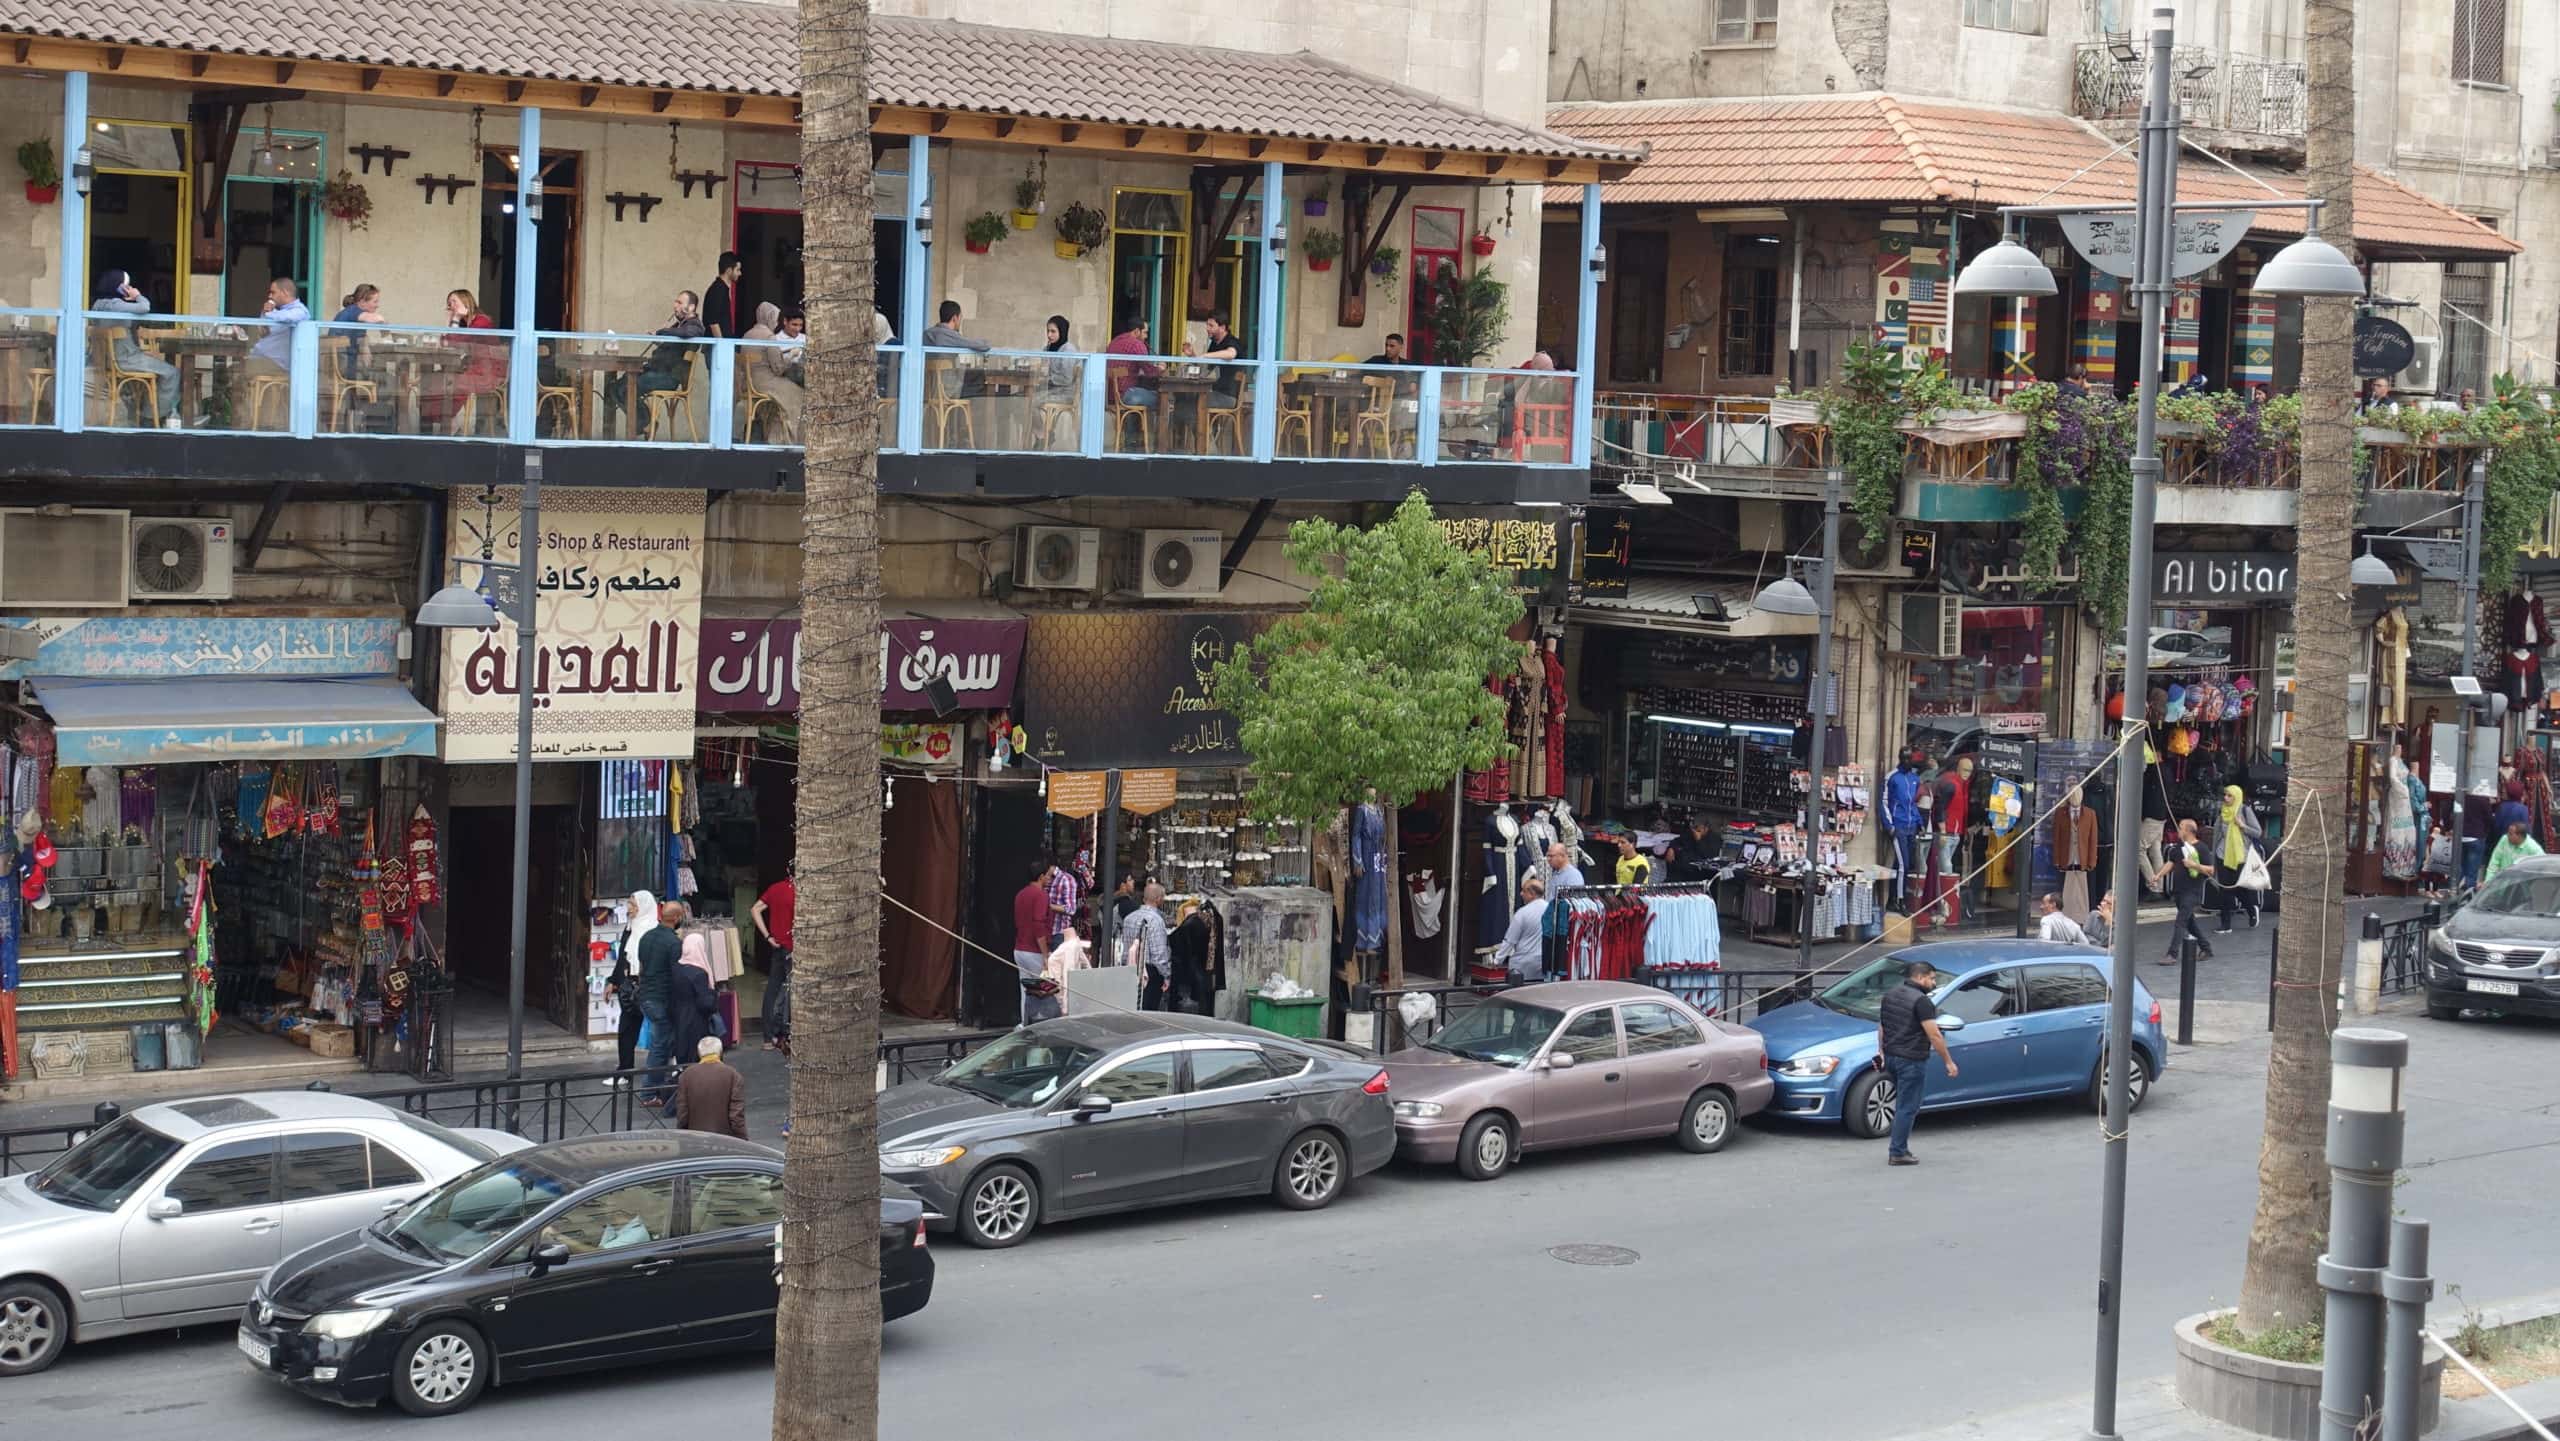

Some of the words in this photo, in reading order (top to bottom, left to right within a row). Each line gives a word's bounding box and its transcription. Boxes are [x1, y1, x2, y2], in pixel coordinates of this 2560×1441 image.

[547, 532, 587, 553] Shop
[592, 533, 603, 550] &
[608, 533, 690, 551] Restaurant
[1192, 535, 1220, 543] SAMSUNG
[537, 565, 600, 598] وكافي
[605, 567, 681, 598] مطعم
[2162, 559, 2194, 593] Al
[2208, 560, 2289, 593] bitar
[170, 622, 361, 672] الشاويش
[1192, 641, 1223, 659] KH
[465, 619, 683, 708] المدية
[899, 630, 1000, 693] سوق
[510, 743, 560, 754] للعائت
[563, 742, 597, 756] خاص
[600, 741, 628, 755] قسم
